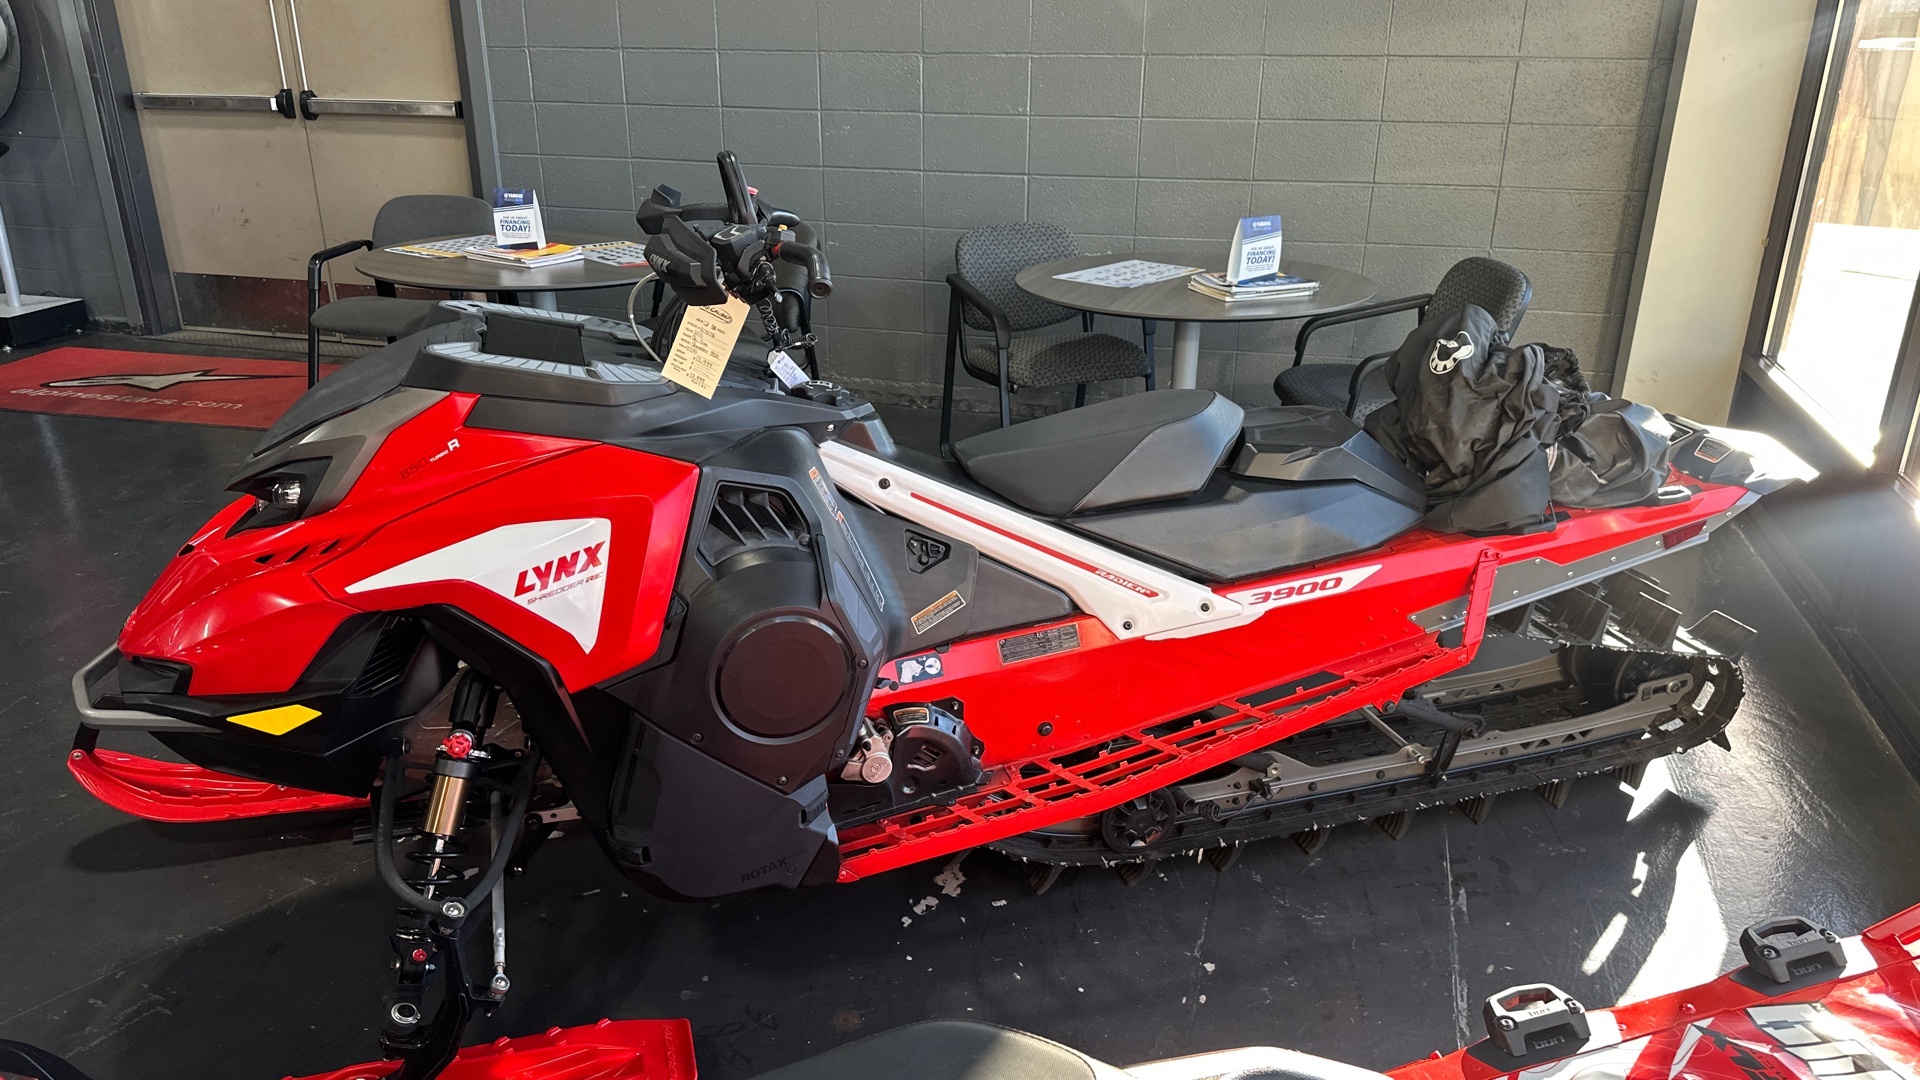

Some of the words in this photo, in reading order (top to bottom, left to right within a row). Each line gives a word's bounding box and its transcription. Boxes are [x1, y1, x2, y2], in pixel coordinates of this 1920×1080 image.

[1246, 255, 1275, 265] TODAY!
[10, 387, 243, 410] alpinestars.com
[400, 457, 428, 480] 850
[429, 449, 449, 463] TURBO
[447, 438, 460, 451] R
[514, 540, 606, 598] LYNX
[527, 579, 584, 605] SHREDDER
[585, 571, 604, 583] RE
[1248, 576, 1343, 605] 3900
[740, 855, 788, 883] ROTAX
